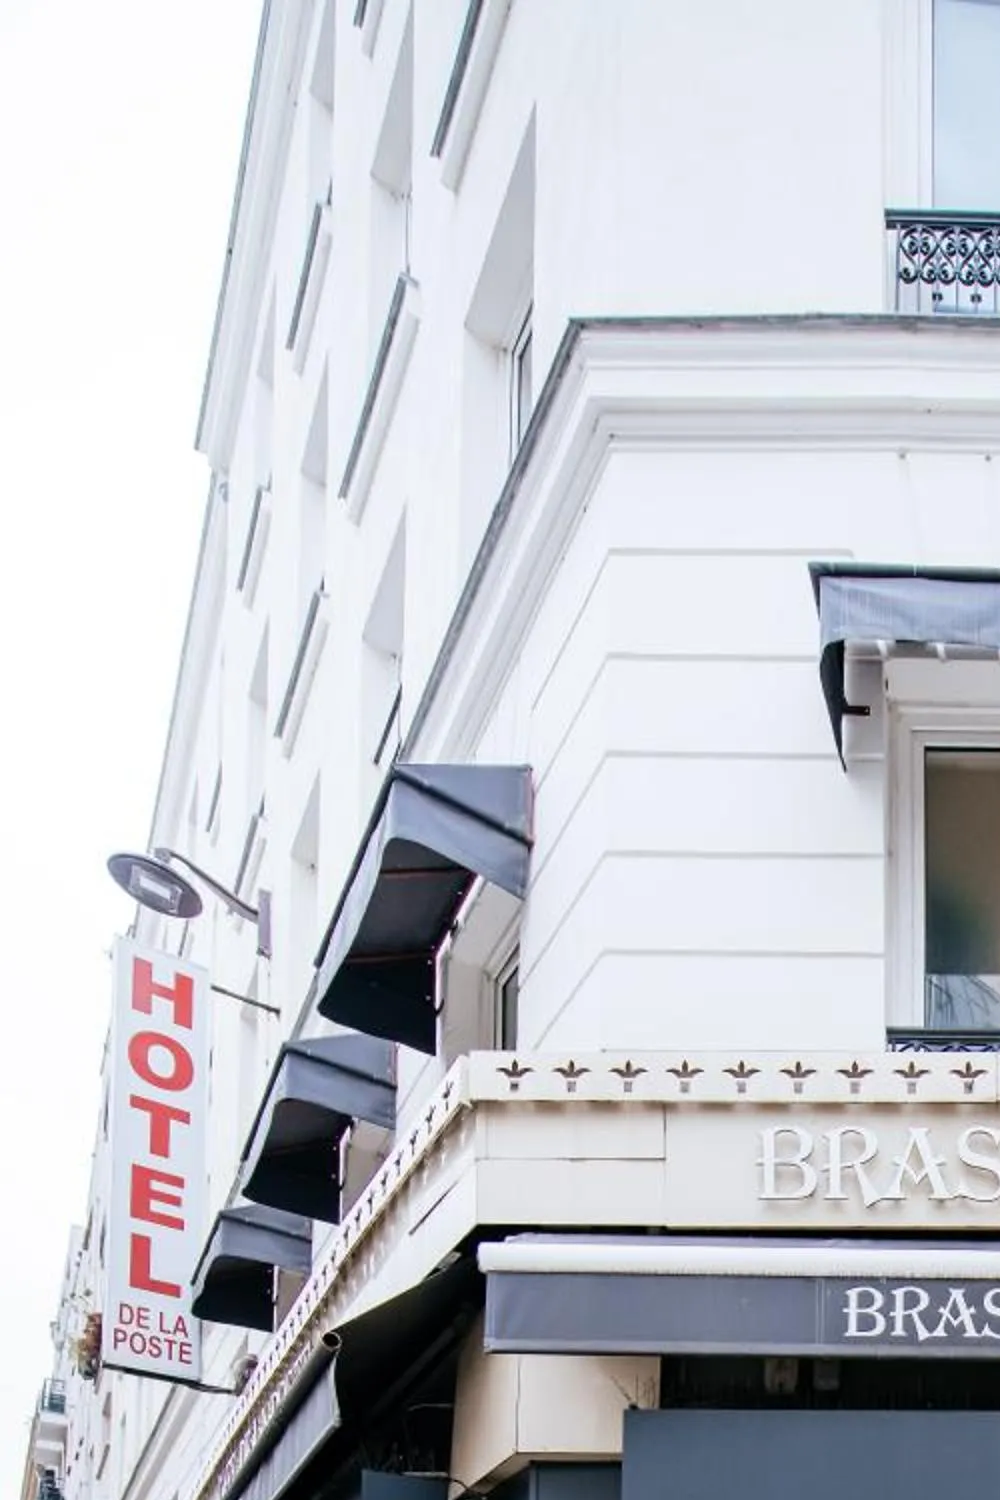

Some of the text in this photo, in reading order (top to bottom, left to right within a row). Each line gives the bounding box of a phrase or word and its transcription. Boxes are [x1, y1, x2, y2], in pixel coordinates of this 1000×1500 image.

[127, 956, 194, 1298] HOTEL
[119, 1303, 188, 1338] DE LA
[113, 1327, 192, 1365] POSTE
